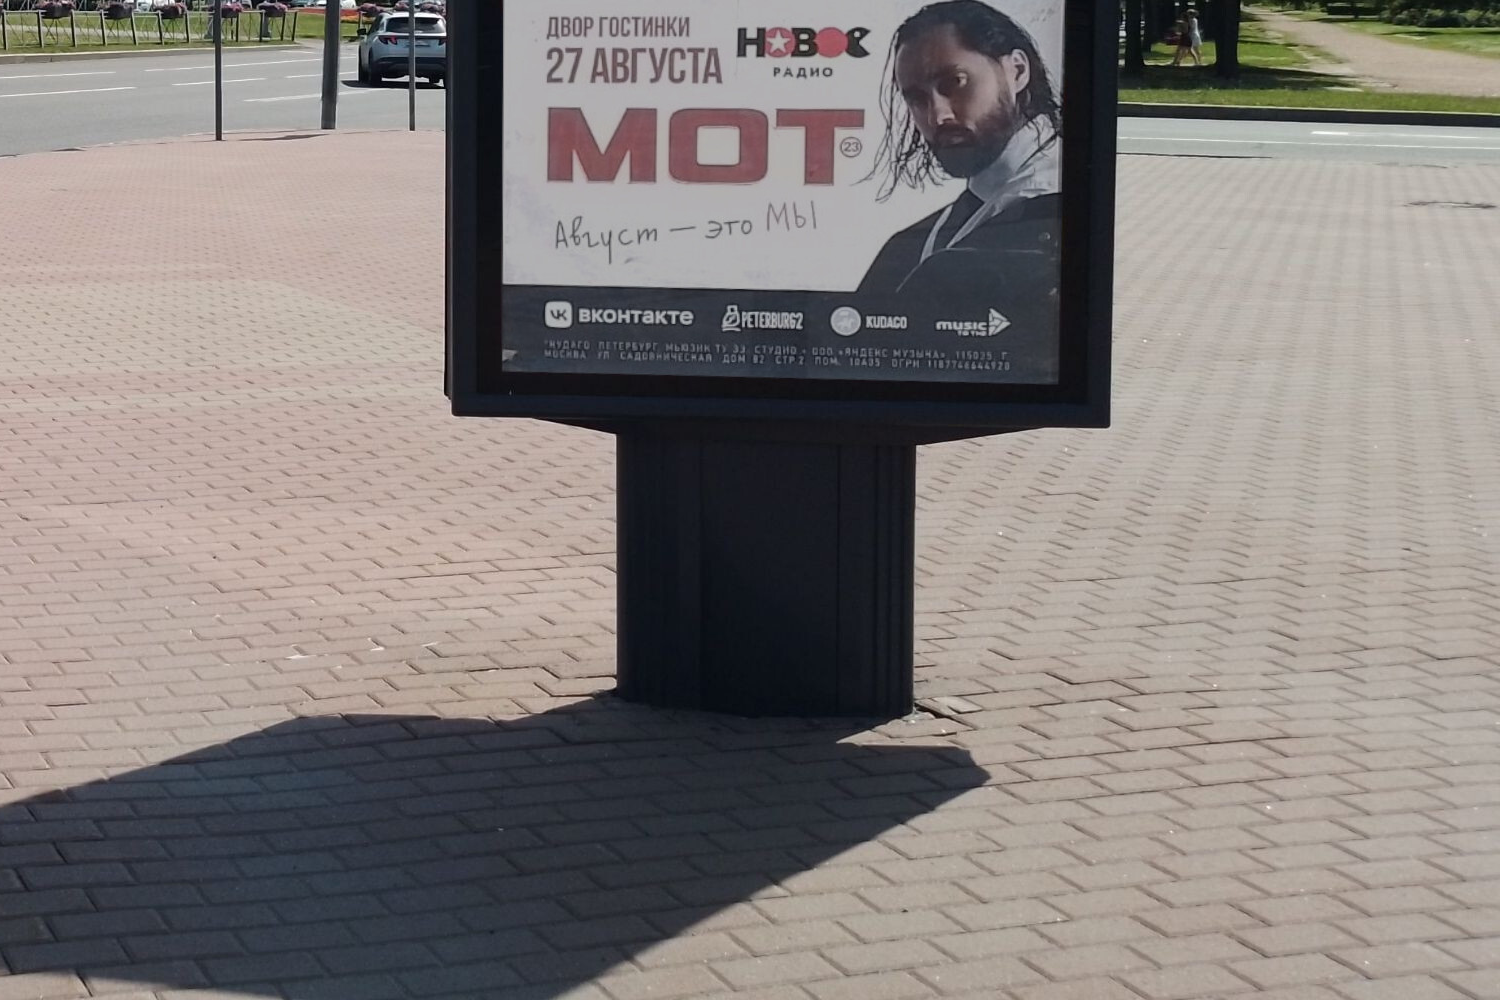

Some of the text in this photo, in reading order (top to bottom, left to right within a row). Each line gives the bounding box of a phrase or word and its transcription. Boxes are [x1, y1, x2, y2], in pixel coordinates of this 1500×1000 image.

[546, 16, 690, 40] ДВОР ГОСТИНКИ
[546, 47, 723, 84] 27 АВГУСТА
[773, 67, 834, 78] РАДИО
[547, 107, 865, 186] МОТ
[555, 216, 658, 264] Август
[705, 220, 753, 239] это
[866, 315, 907, 329] KUDAGO
